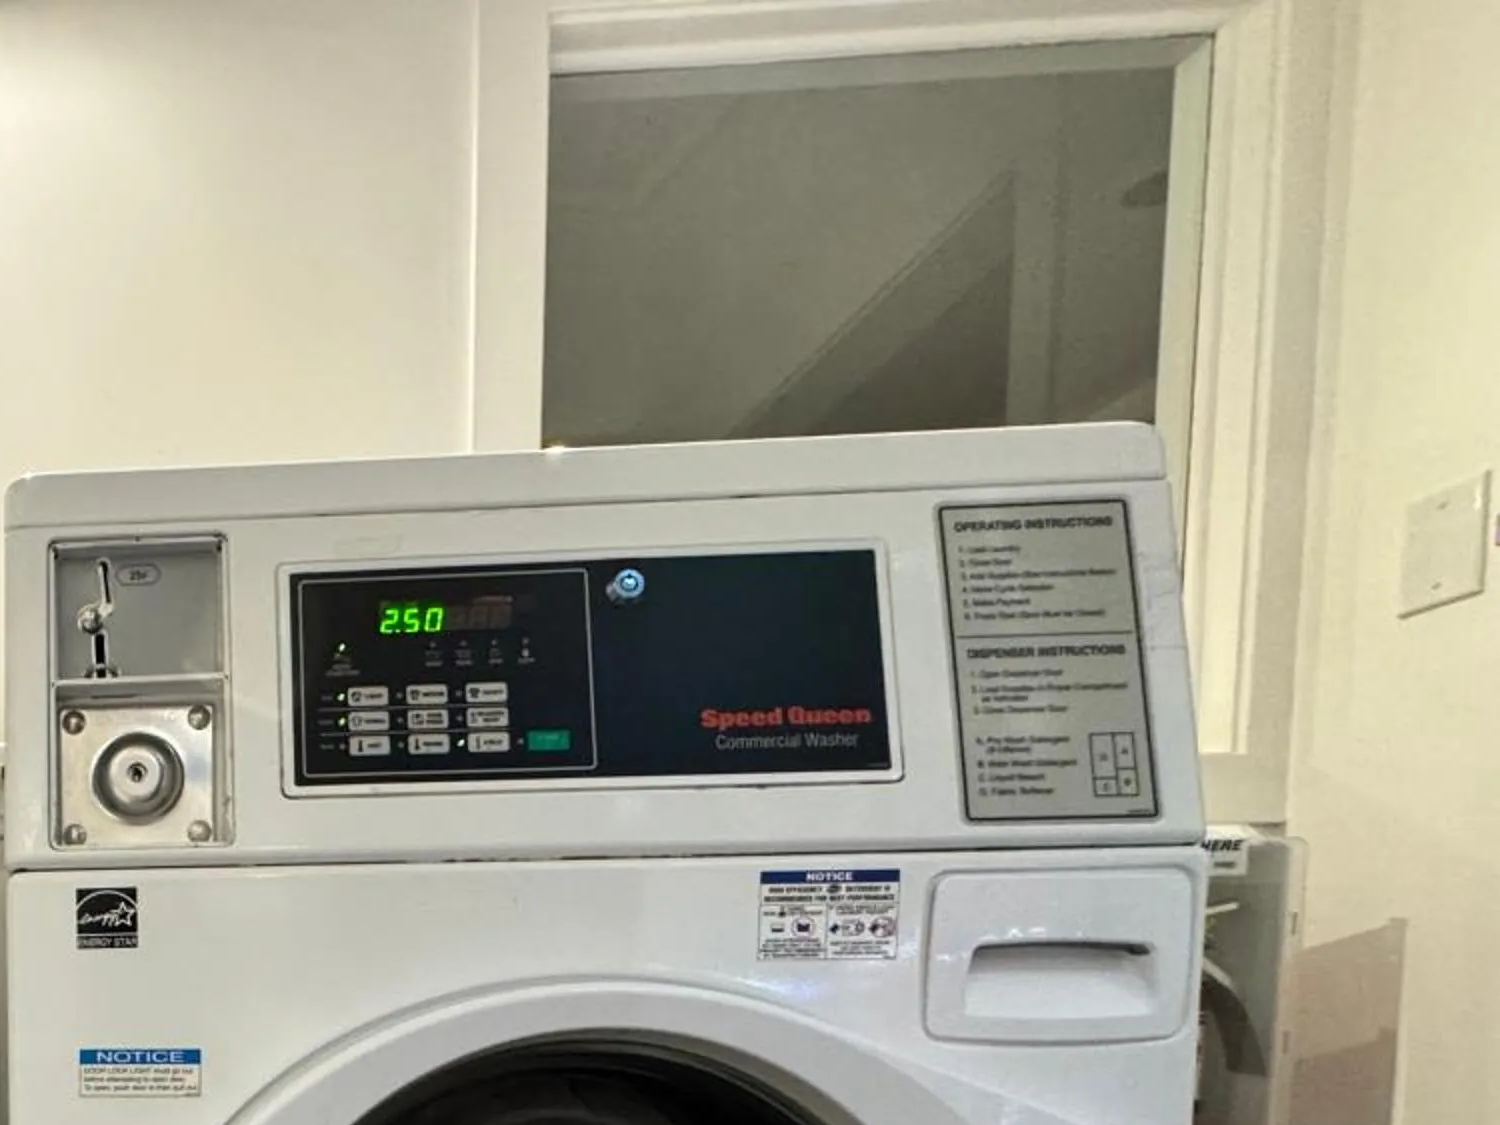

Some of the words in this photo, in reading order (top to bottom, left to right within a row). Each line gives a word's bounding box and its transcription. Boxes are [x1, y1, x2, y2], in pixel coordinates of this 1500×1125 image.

[954, 520, 1022, 532] OPERATING
[1024, 516, 1113, 529] INSTRUCTIONS
[701, 707, 783, 731] Speed
[787, 705, 871, 725] Queen
[715, 734, 799, 750] Commercial
[804, 732, 858, 747] Washer
[806, 872, 853, 881] NOTICE
[96, 1051, 184, 1063] NOTICE
